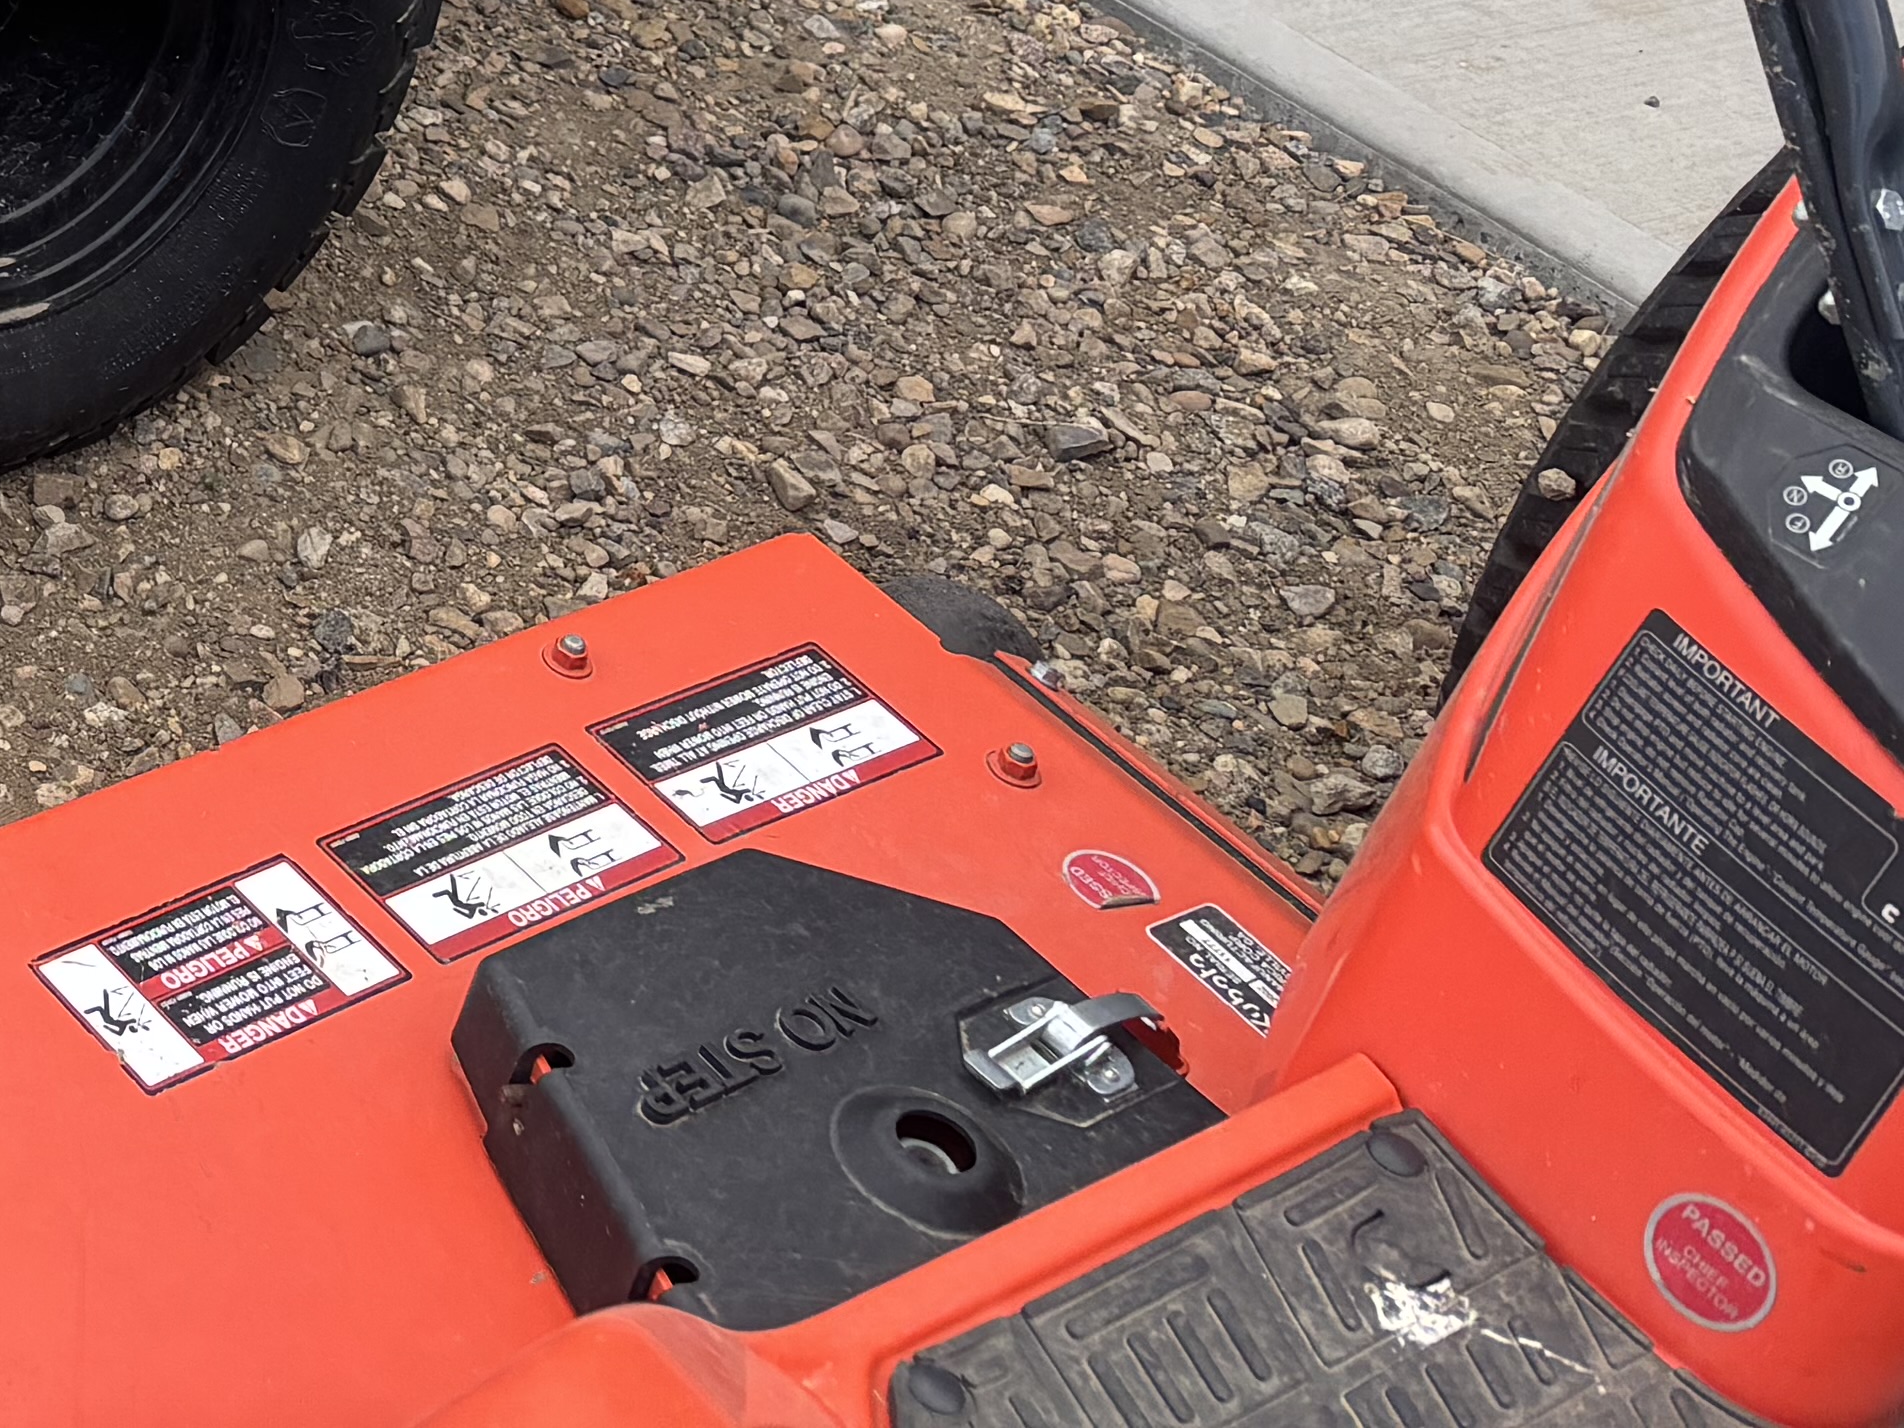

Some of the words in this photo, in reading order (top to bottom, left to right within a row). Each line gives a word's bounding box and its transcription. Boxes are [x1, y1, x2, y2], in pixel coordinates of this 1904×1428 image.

[1670, 632, 1781, 733] IMPORTANT
[769, 772, 852, 814] DANGER
[1589, 744, 1711, 857] IMPORTANTE
[1070, 866, 1113, 900] SSED
[503, 881, 592, 928] PELIGRO
[155, 940, 250, 990] PELIGRO
[243, 969, 262, 982] IS
[255, 951, 301, 977] ENGINE
[279, 962, 312, 983] FEET
[253, 974, 285, 994] INTO
[278, 981, 307, 1000] NOT
[301, 974, 324, 989] DO
[1189, 952, 1272, 1033] Kubota
[212, 986, 258, 1013] MOWER
[218, 1001, 263, 1027] HANDS
[256, 991, 284, 1009] PUT
[179, 1004, 219, 1027] WHEN
[200, 1018, 226, 1035] OR
[215, 1004, 307, 1054] DANGER
[777, 982, 880, 1055] NO
[638, 1026, 783, 1128] STEP
[1682, 1203, 1766, 1288] PASSED
